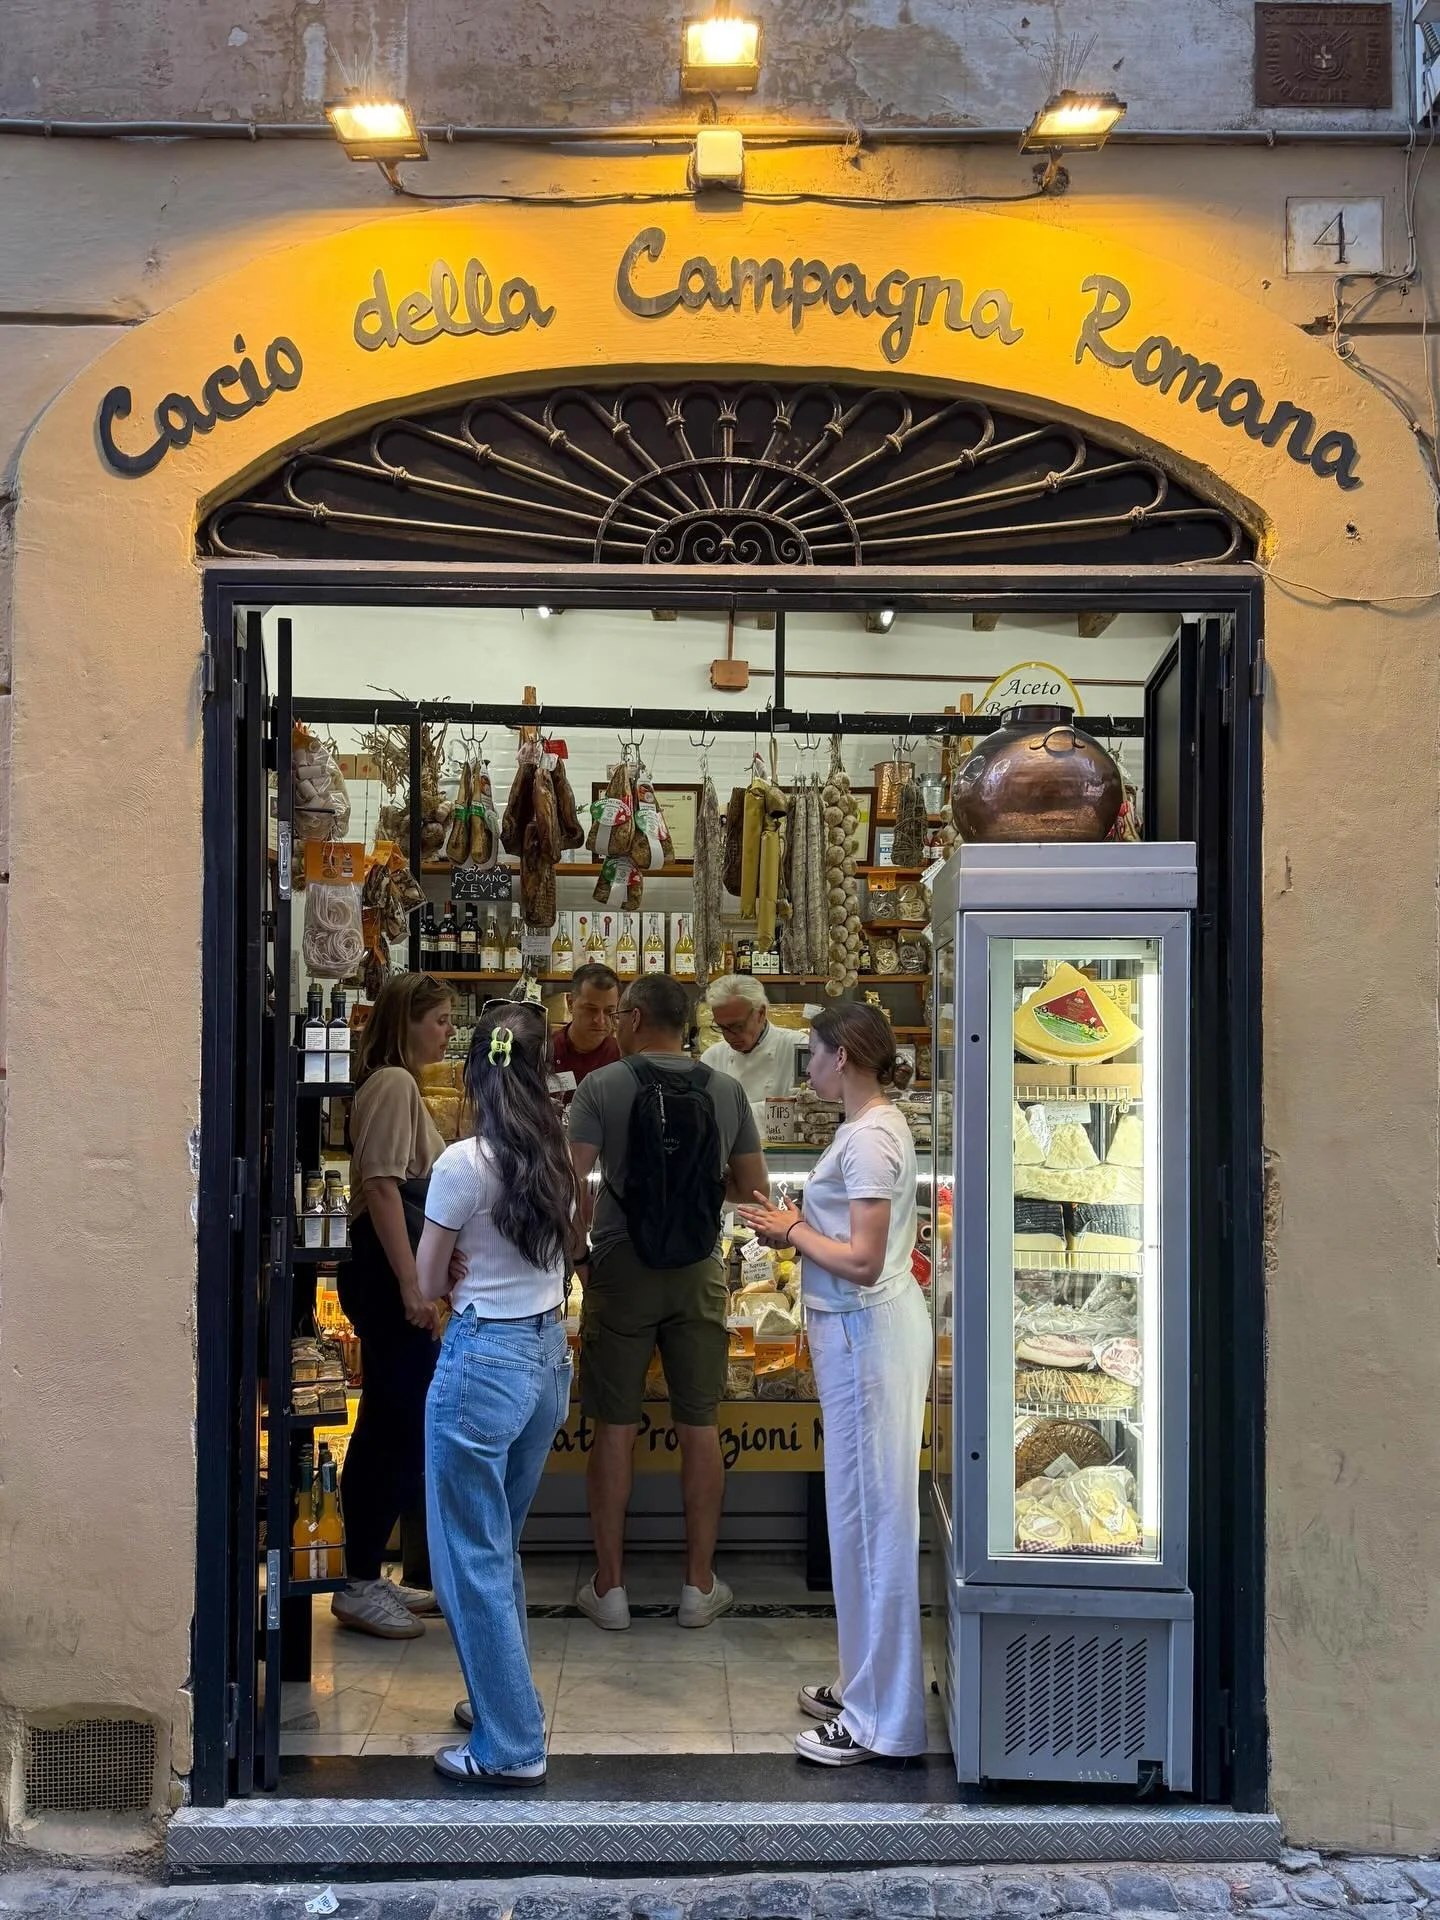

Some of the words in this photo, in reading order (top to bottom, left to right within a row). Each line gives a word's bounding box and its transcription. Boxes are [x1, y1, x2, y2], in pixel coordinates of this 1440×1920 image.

[1313, 208, 1358, 264] 4
[98, 334, 302, 476] Cacio
[353, 258, 555, 351] della
[615, 227, 1024, 364] Campagna
[1075, 274, 1361, 491] Romana
[1001, 679, 1061, 696] Aceto
[454, 872, 509, 883] ROMANO
[769, 1105, 790, 1119] TIPS
